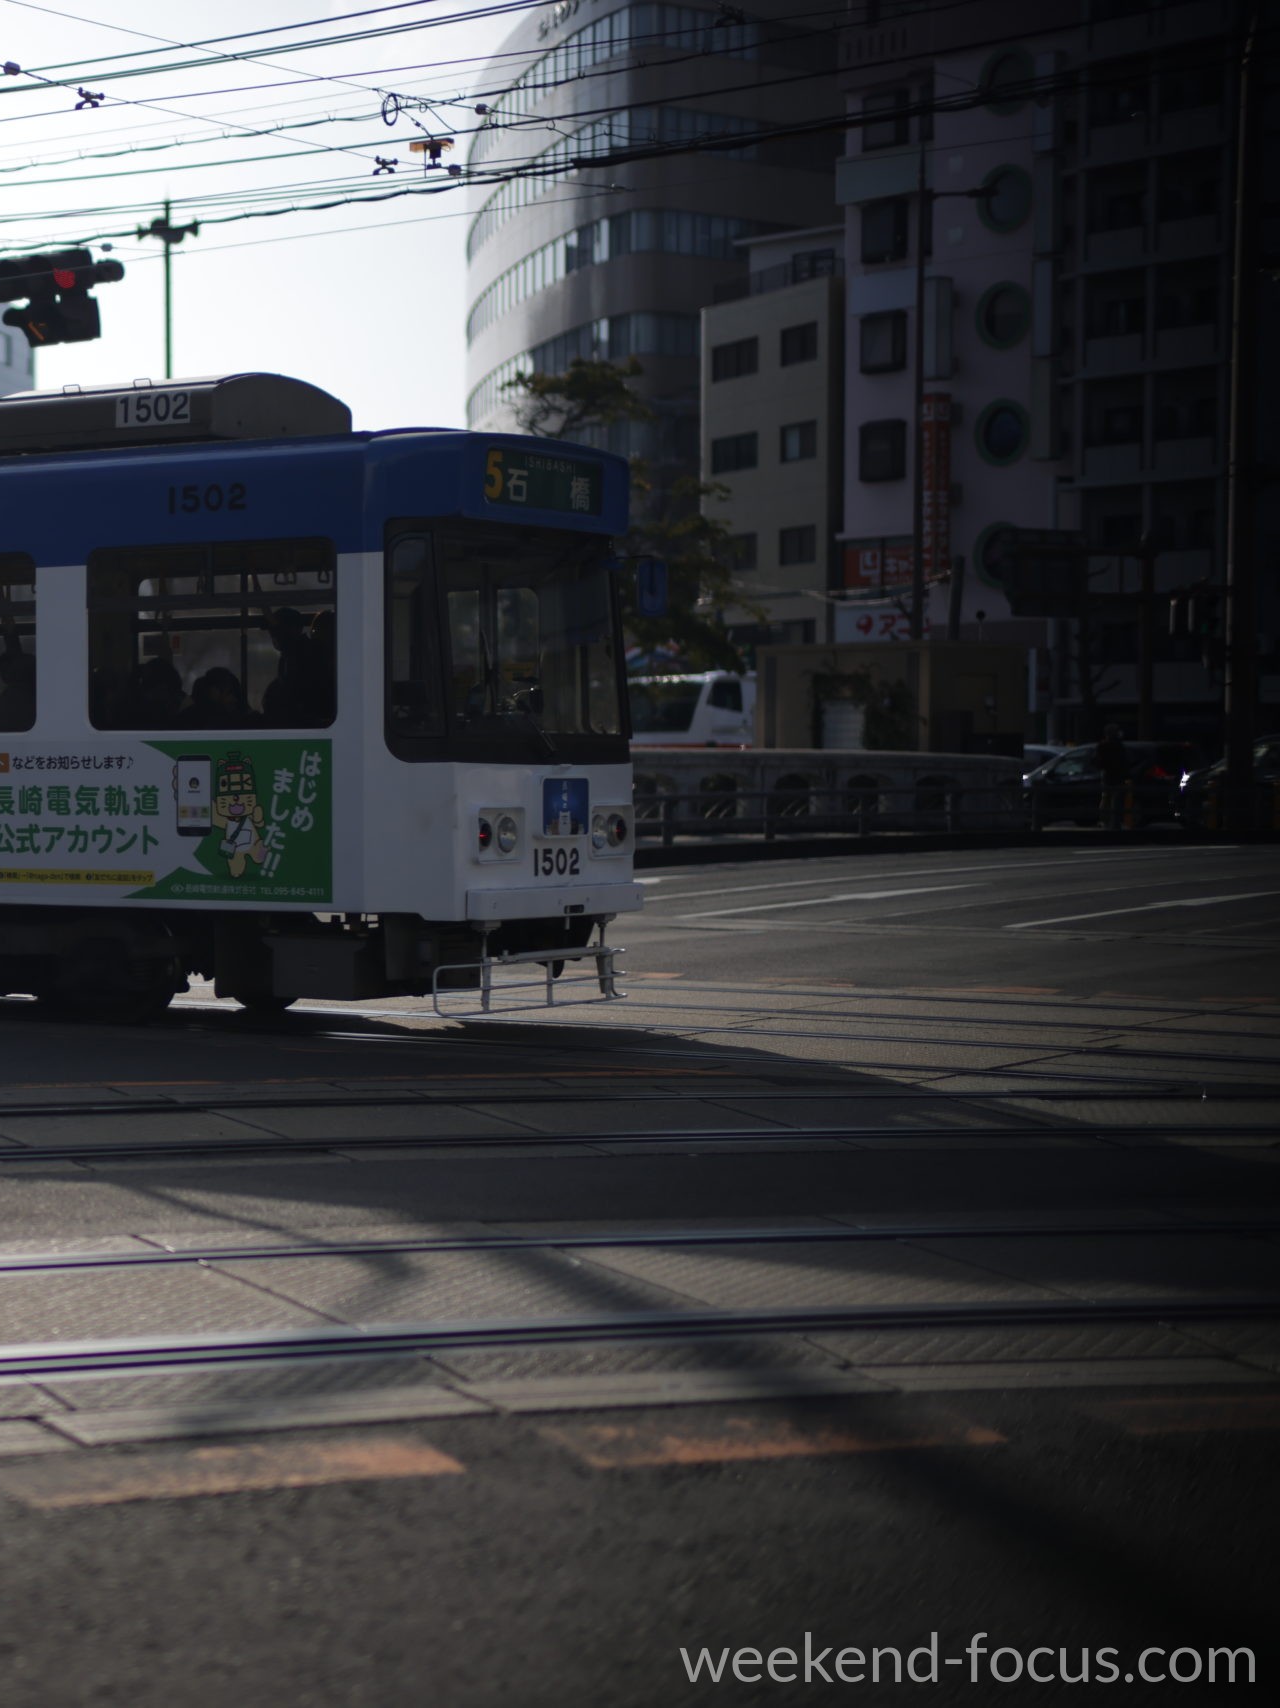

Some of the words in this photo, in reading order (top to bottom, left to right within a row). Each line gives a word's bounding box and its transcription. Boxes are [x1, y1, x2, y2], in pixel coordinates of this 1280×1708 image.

[119, 392, 190, 426] 1502
[483, 450, 505, 500] 5
[168, 483, 247, 514] 1502
[290, 749, 322, 832] はじめ
[533, 848, 580, 877] 1502
